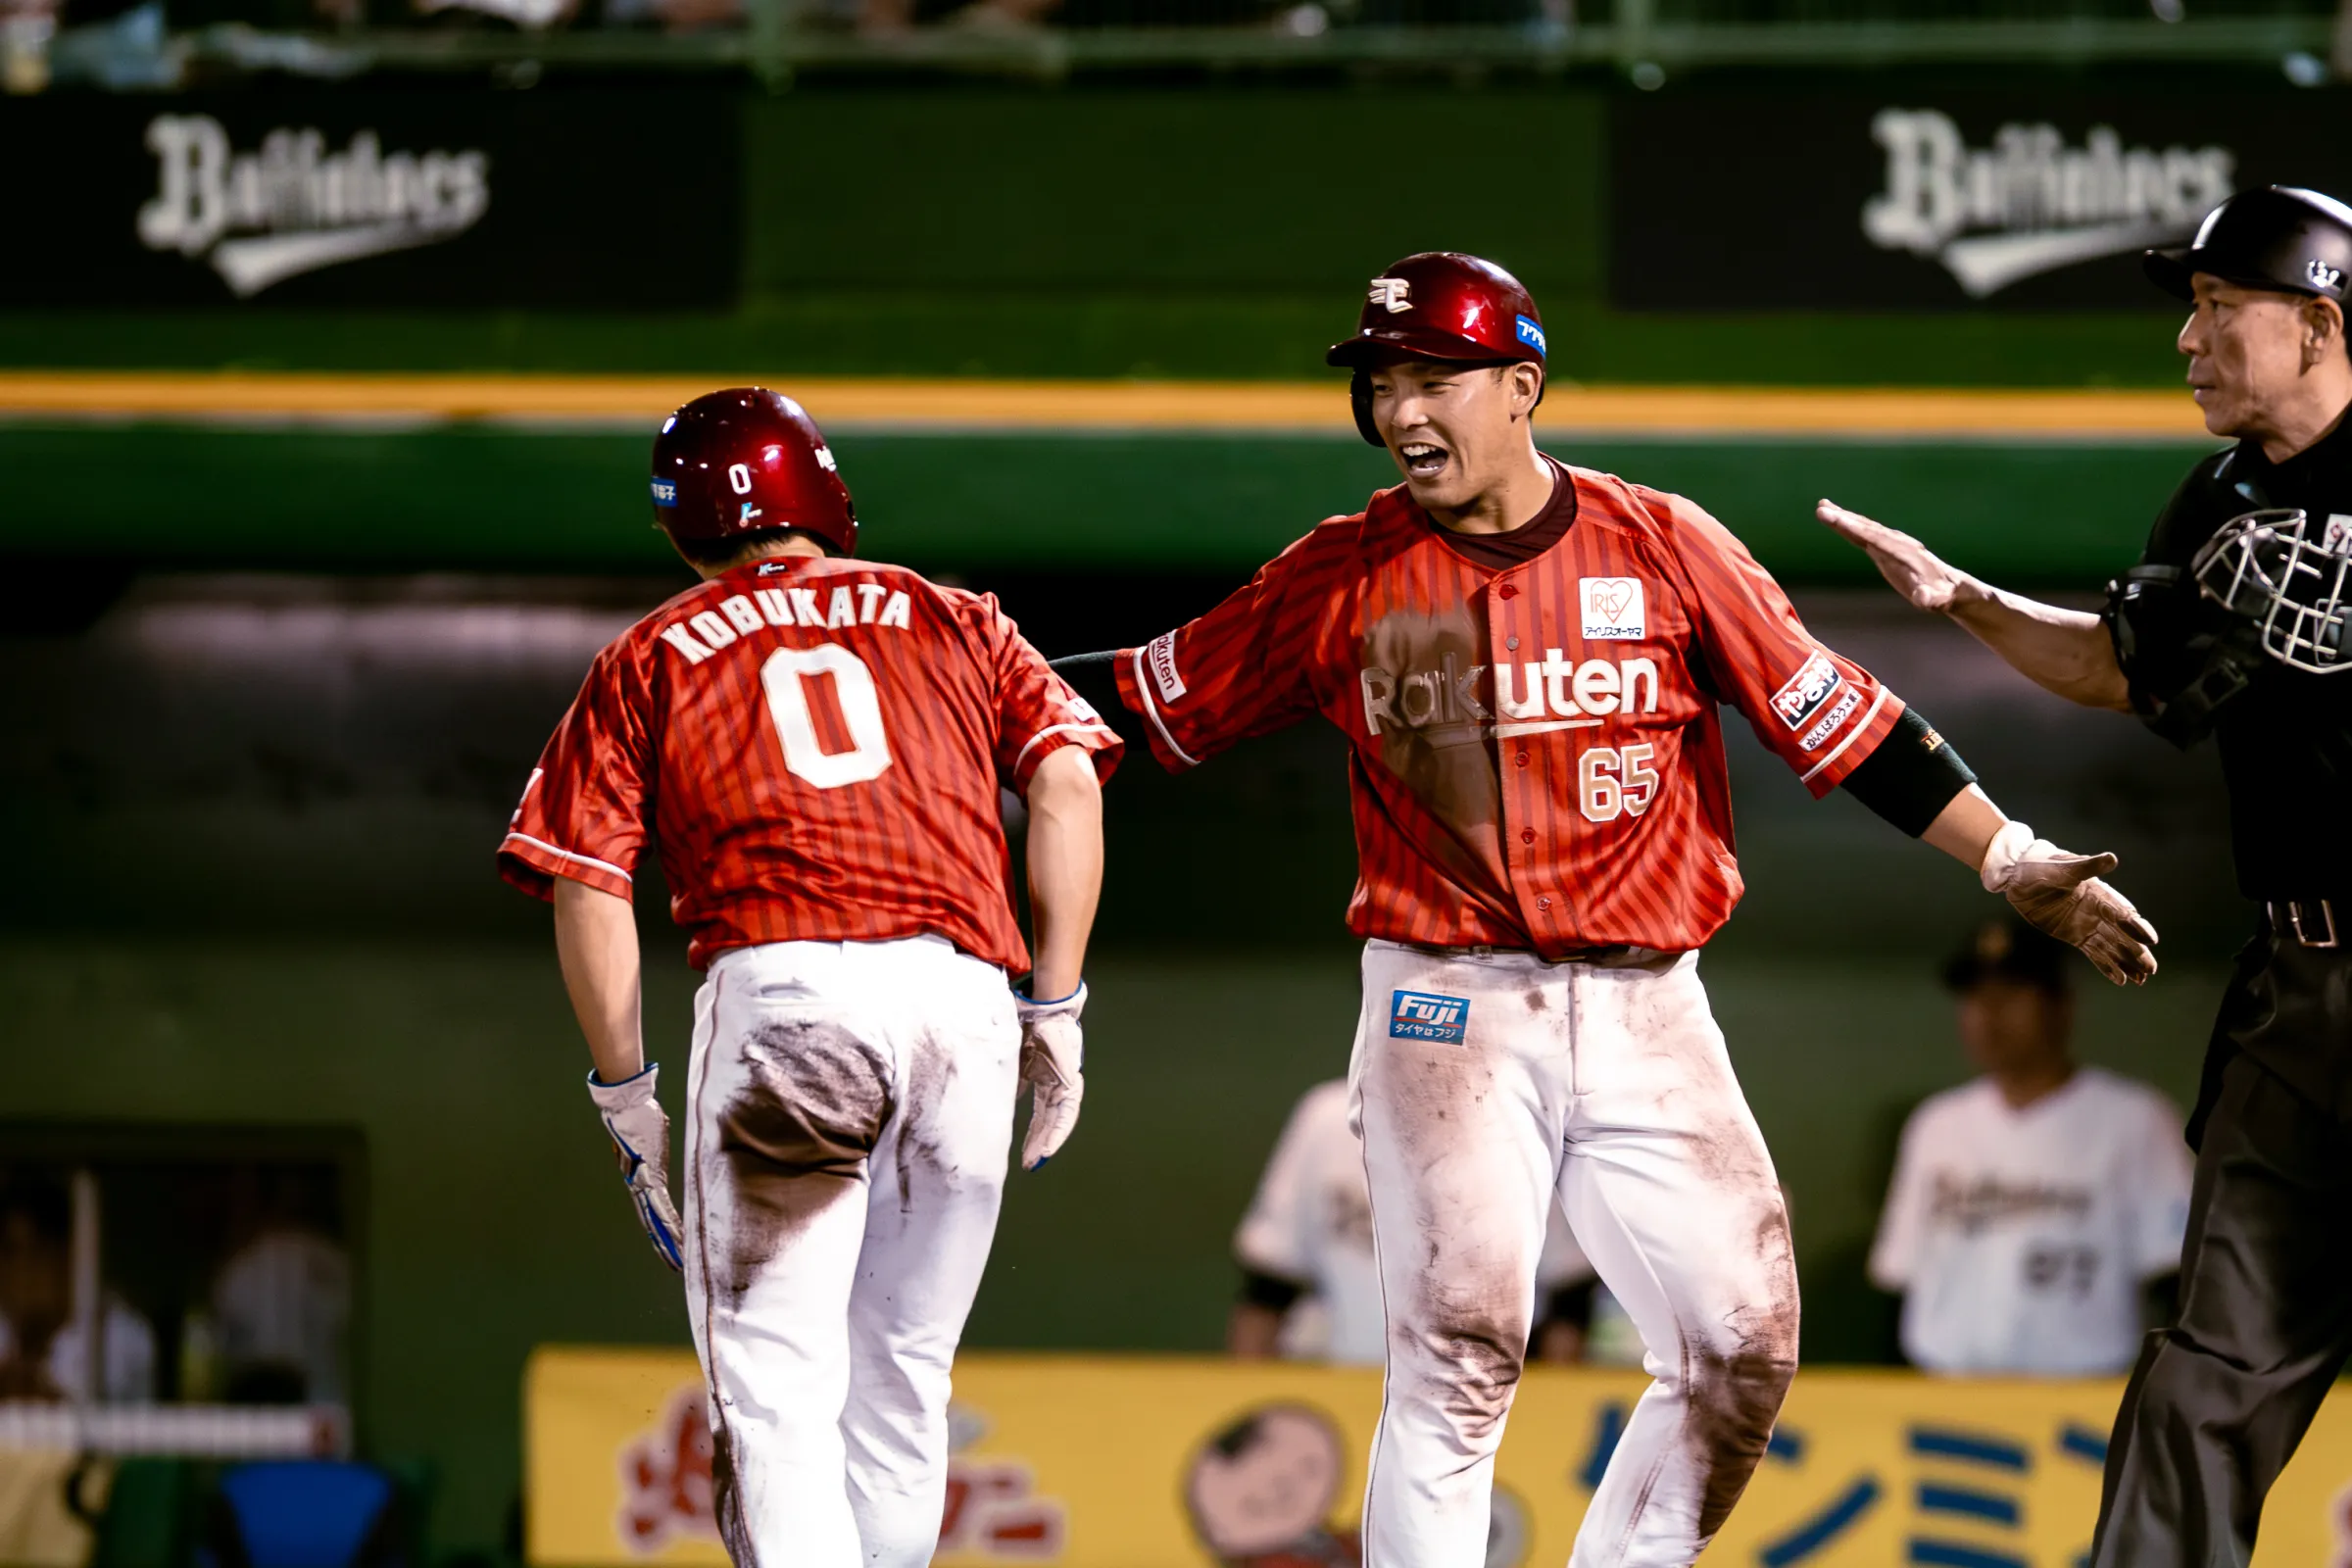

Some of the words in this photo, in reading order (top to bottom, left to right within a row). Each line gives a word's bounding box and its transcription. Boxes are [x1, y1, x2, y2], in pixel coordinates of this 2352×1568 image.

[728, 463, 752, 495] 0
[660, 583, 912, 665] KOBUKATA
[1590, 593, 1620, 613] IRIS
[1157, 634, 1176, 691] akuten
[1360, 648, 1659, 736] Rakuten
[1778, 656, 1836, 719] やまや
[760, 642, 894, 790] 0
[1578, 742, 1659, 822] 65
[1395, 1023, 1456, 1039] タイヤはフジ
[1396, 994, 1463, 1026] Fuji
